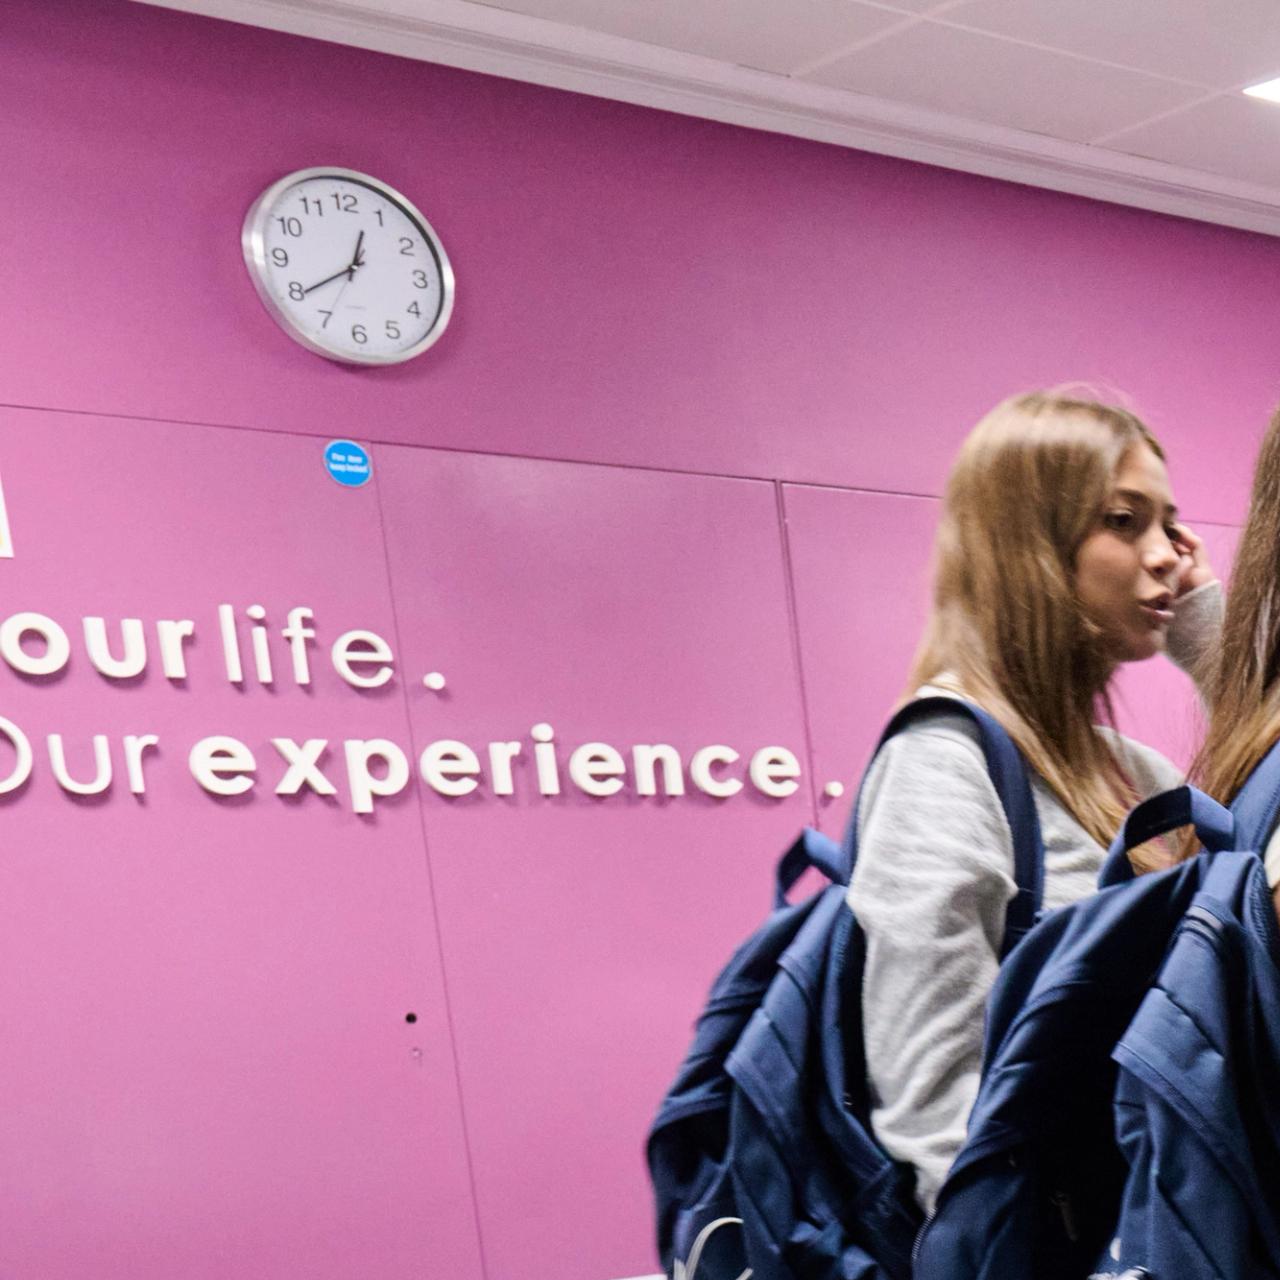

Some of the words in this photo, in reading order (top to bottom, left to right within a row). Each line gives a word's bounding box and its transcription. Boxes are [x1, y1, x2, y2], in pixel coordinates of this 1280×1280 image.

[299, 197, 323, 217] 11
[331, 192, 359, 214] 12
[276, 216, 302, 237] 10
[373, 209, 383, 227] 1
[399, 237, 415, 256] 2
[272, 248, 288, 268] 9
[412, 270, 428, 289] 3
[288, 281, 305, 301] 8
[317, 309, 333, 328] 7
[407, 301, 422, 318] 4
[352, 324, 368, 344] 6
[385, 320, 400, 339] 5
